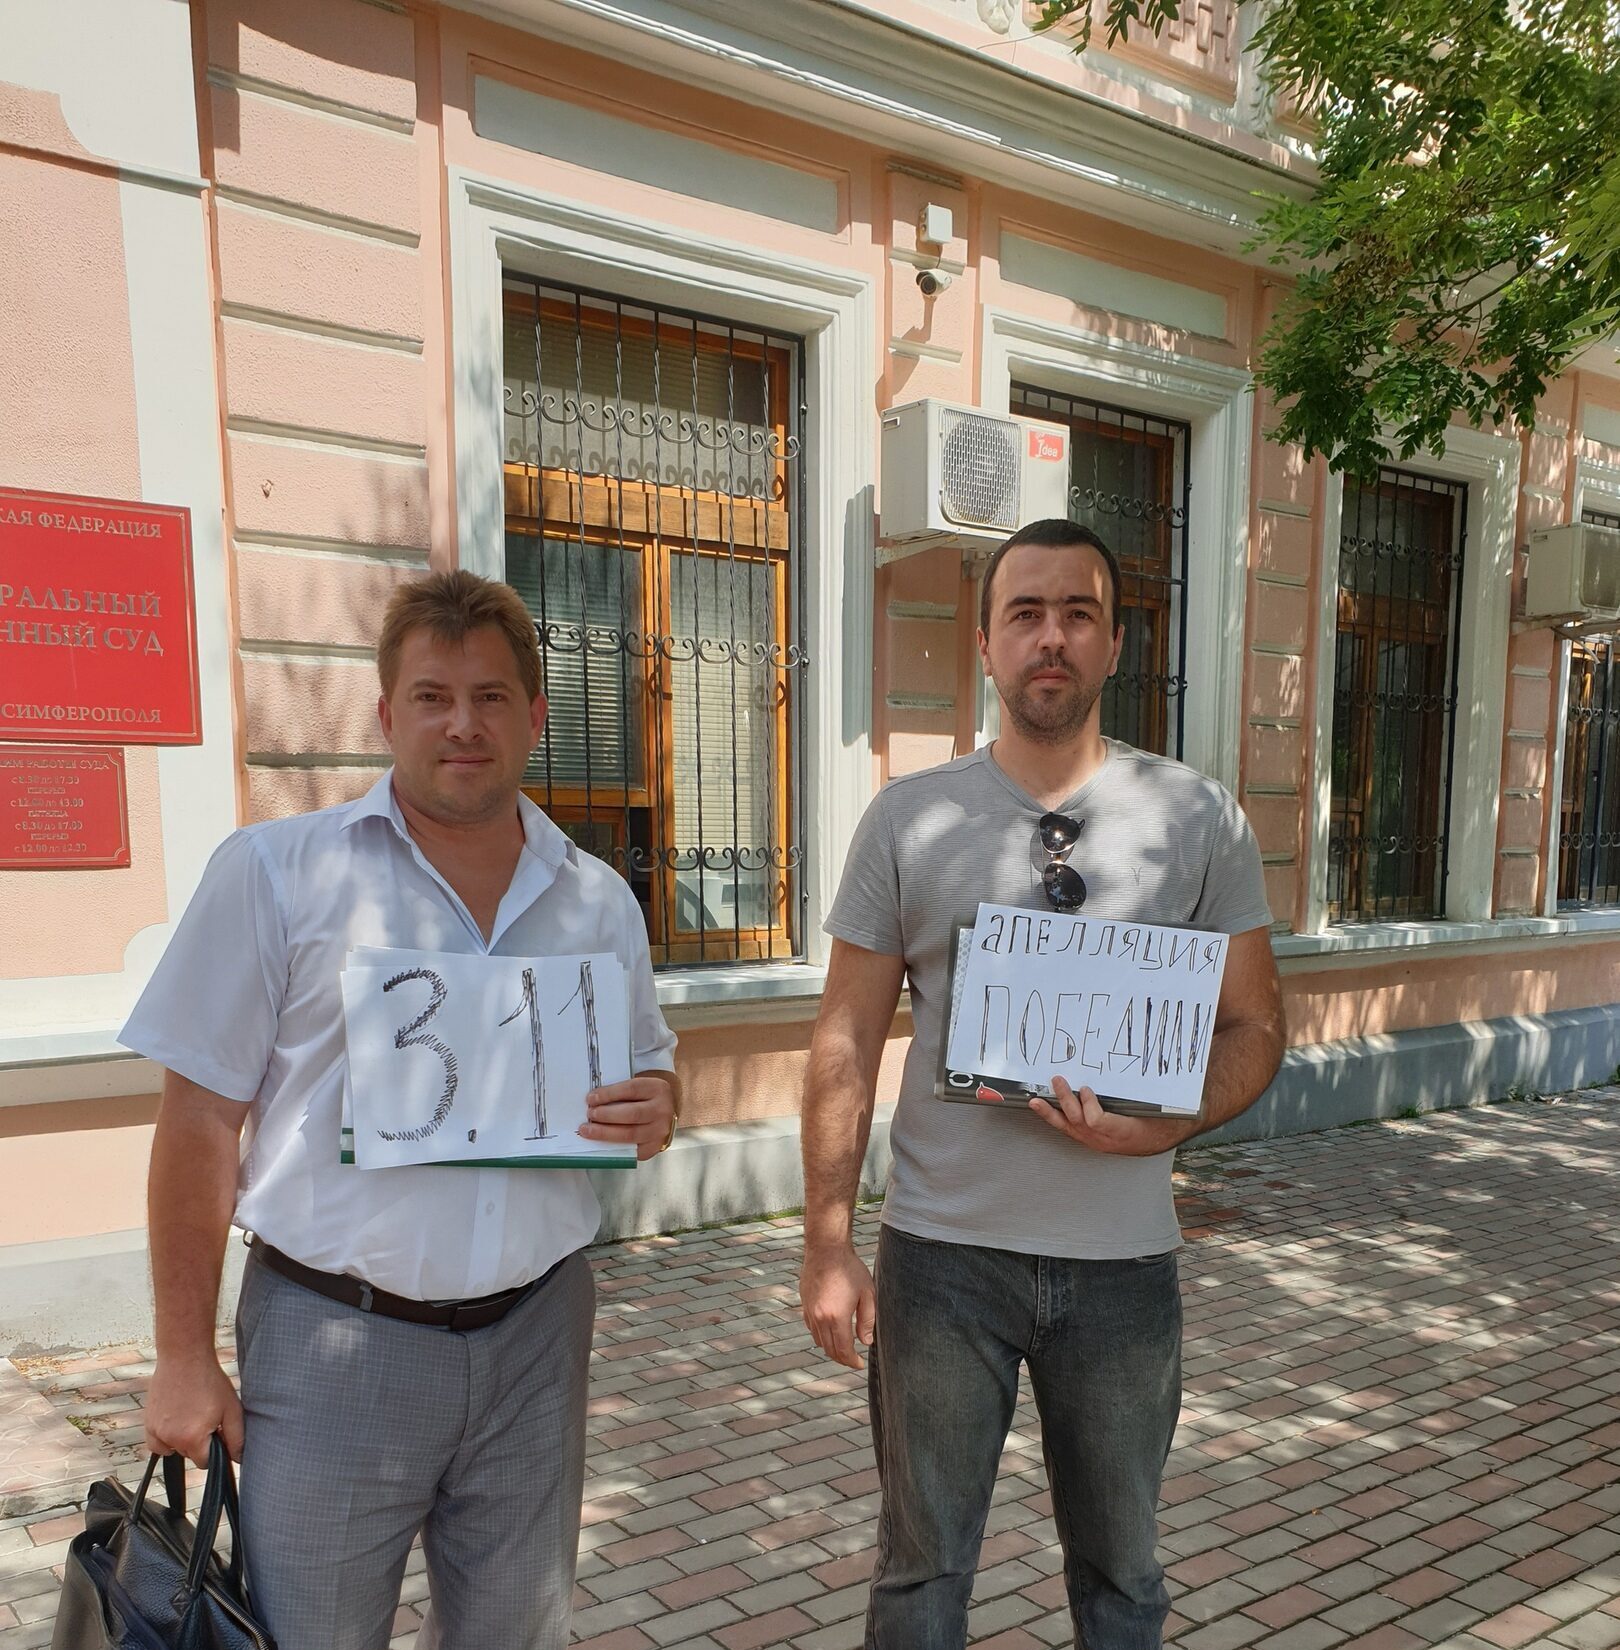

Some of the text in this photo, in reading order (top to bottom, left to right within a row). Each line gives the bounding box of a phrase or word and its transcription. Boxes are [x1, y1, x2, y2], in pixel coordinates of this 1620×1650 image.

[38, 511, 162, 539] ФЕДЕРАЦИЯ
[0, 584, 162, 617] РАЛЬНЫЙ
[103, 627, 164, 657] СУД
[1, 703, 162, 723] СИМФЕРОПОЛЯ
[80, 760, 110, 770] СУДА
[979, 985, 1212, 1076] ПОБЕДИЛИ
[377, 960, 602, 1143] 3.11
